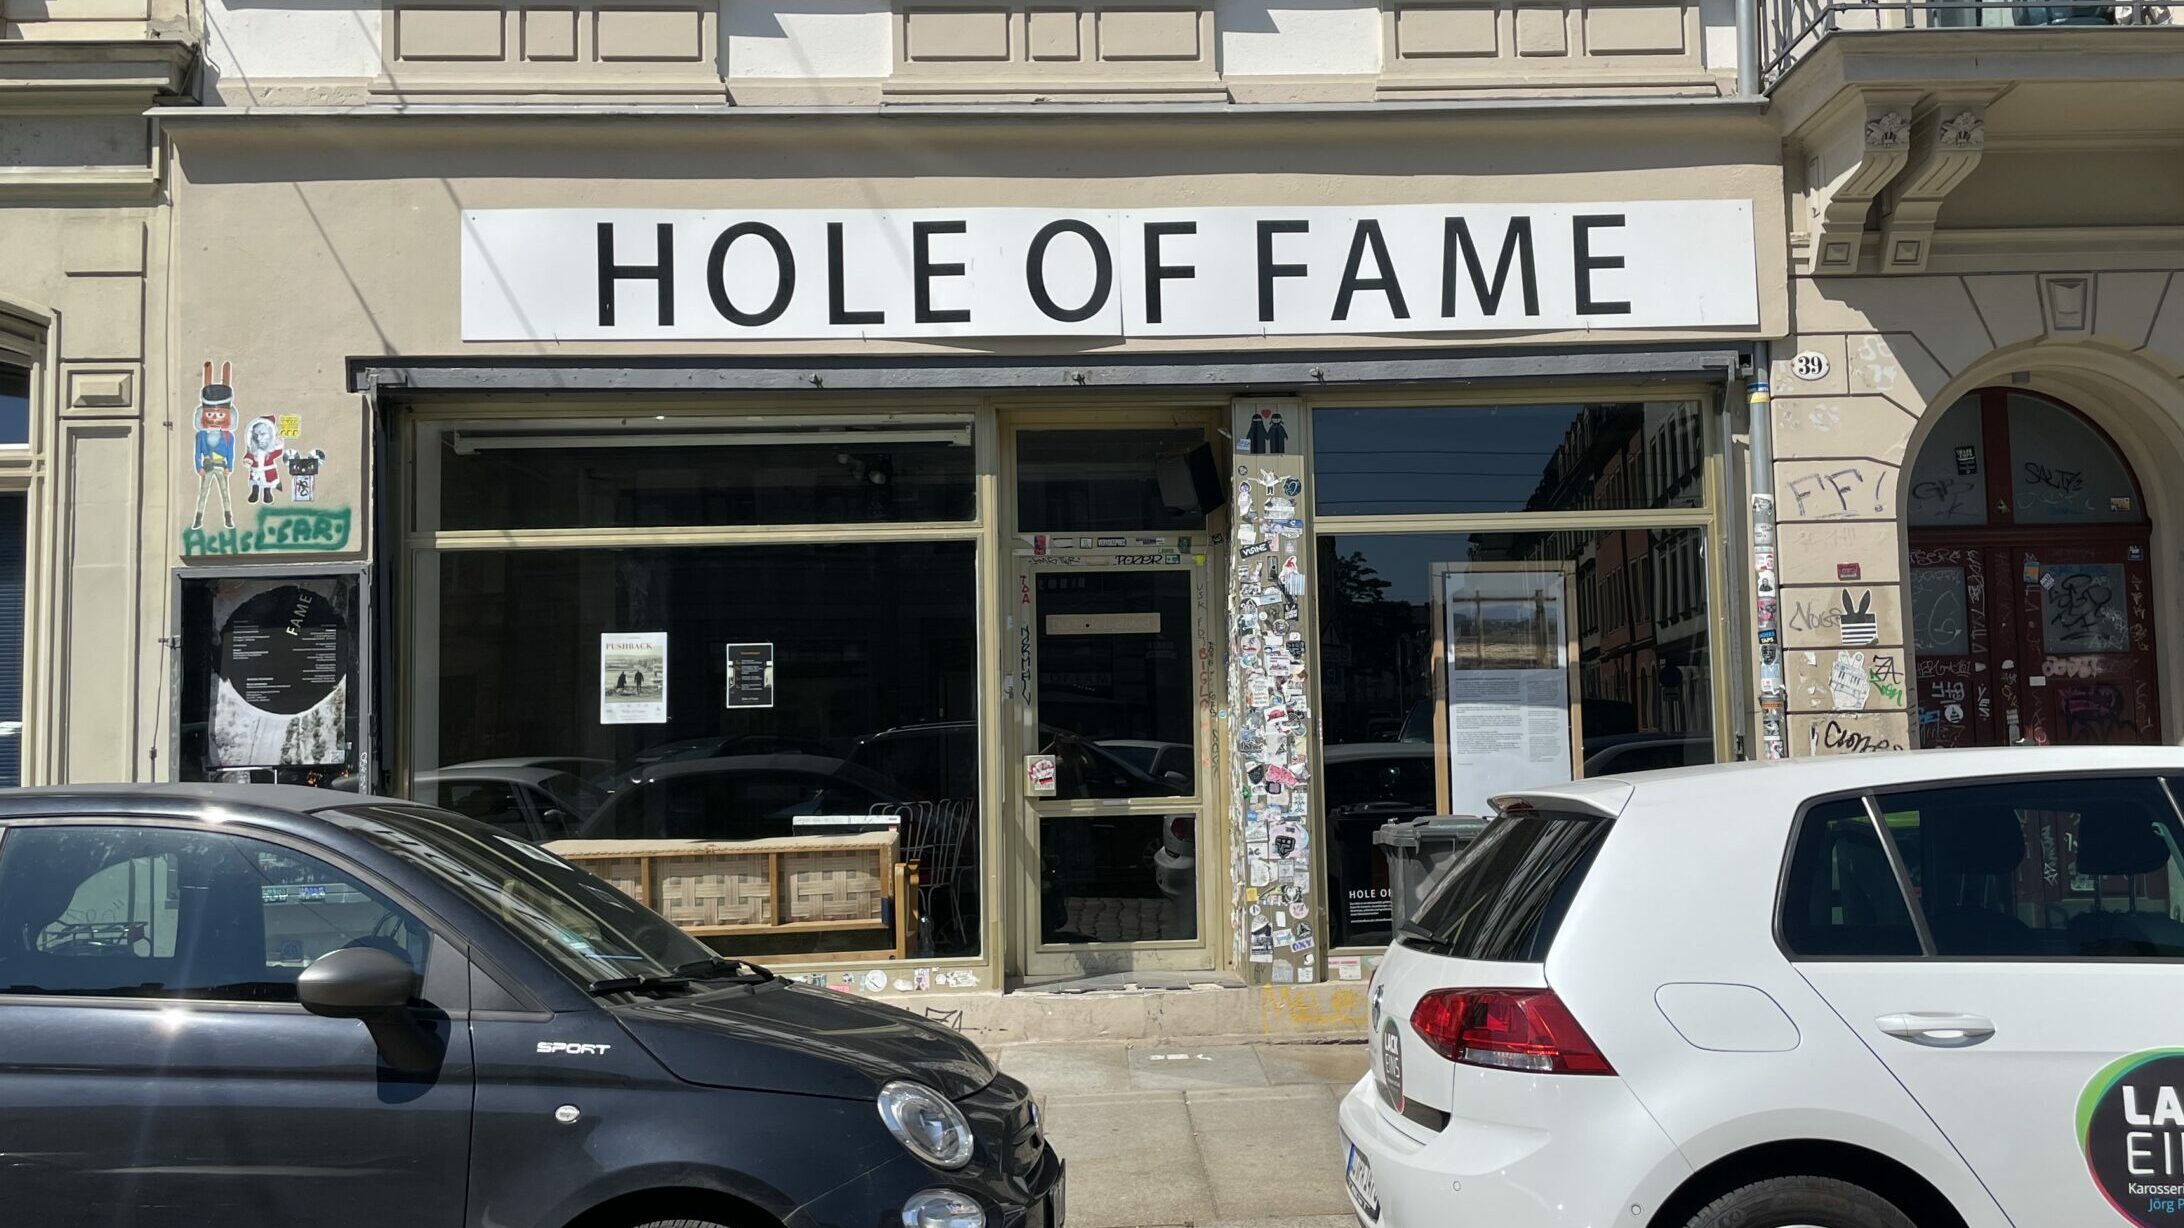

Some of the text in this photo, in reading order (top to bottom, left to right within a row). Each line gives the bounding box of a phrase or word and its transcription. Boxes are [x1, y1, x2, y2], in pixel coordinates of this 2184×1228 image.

[597, 214, 1631, 327] HOLE OF FAME
[1798, 355, 1823, 375] 39
[286, 593, 313, 636] FAME
[1349, 889, 1376, 899] HOLE
[536, 1042, 611, 1055] SPORT
[2122, 1085, 2184, 1126] LA
[2126, 1131, 2184, 1175] EI
[2147, 1198, 2175, 1213] Jörg
